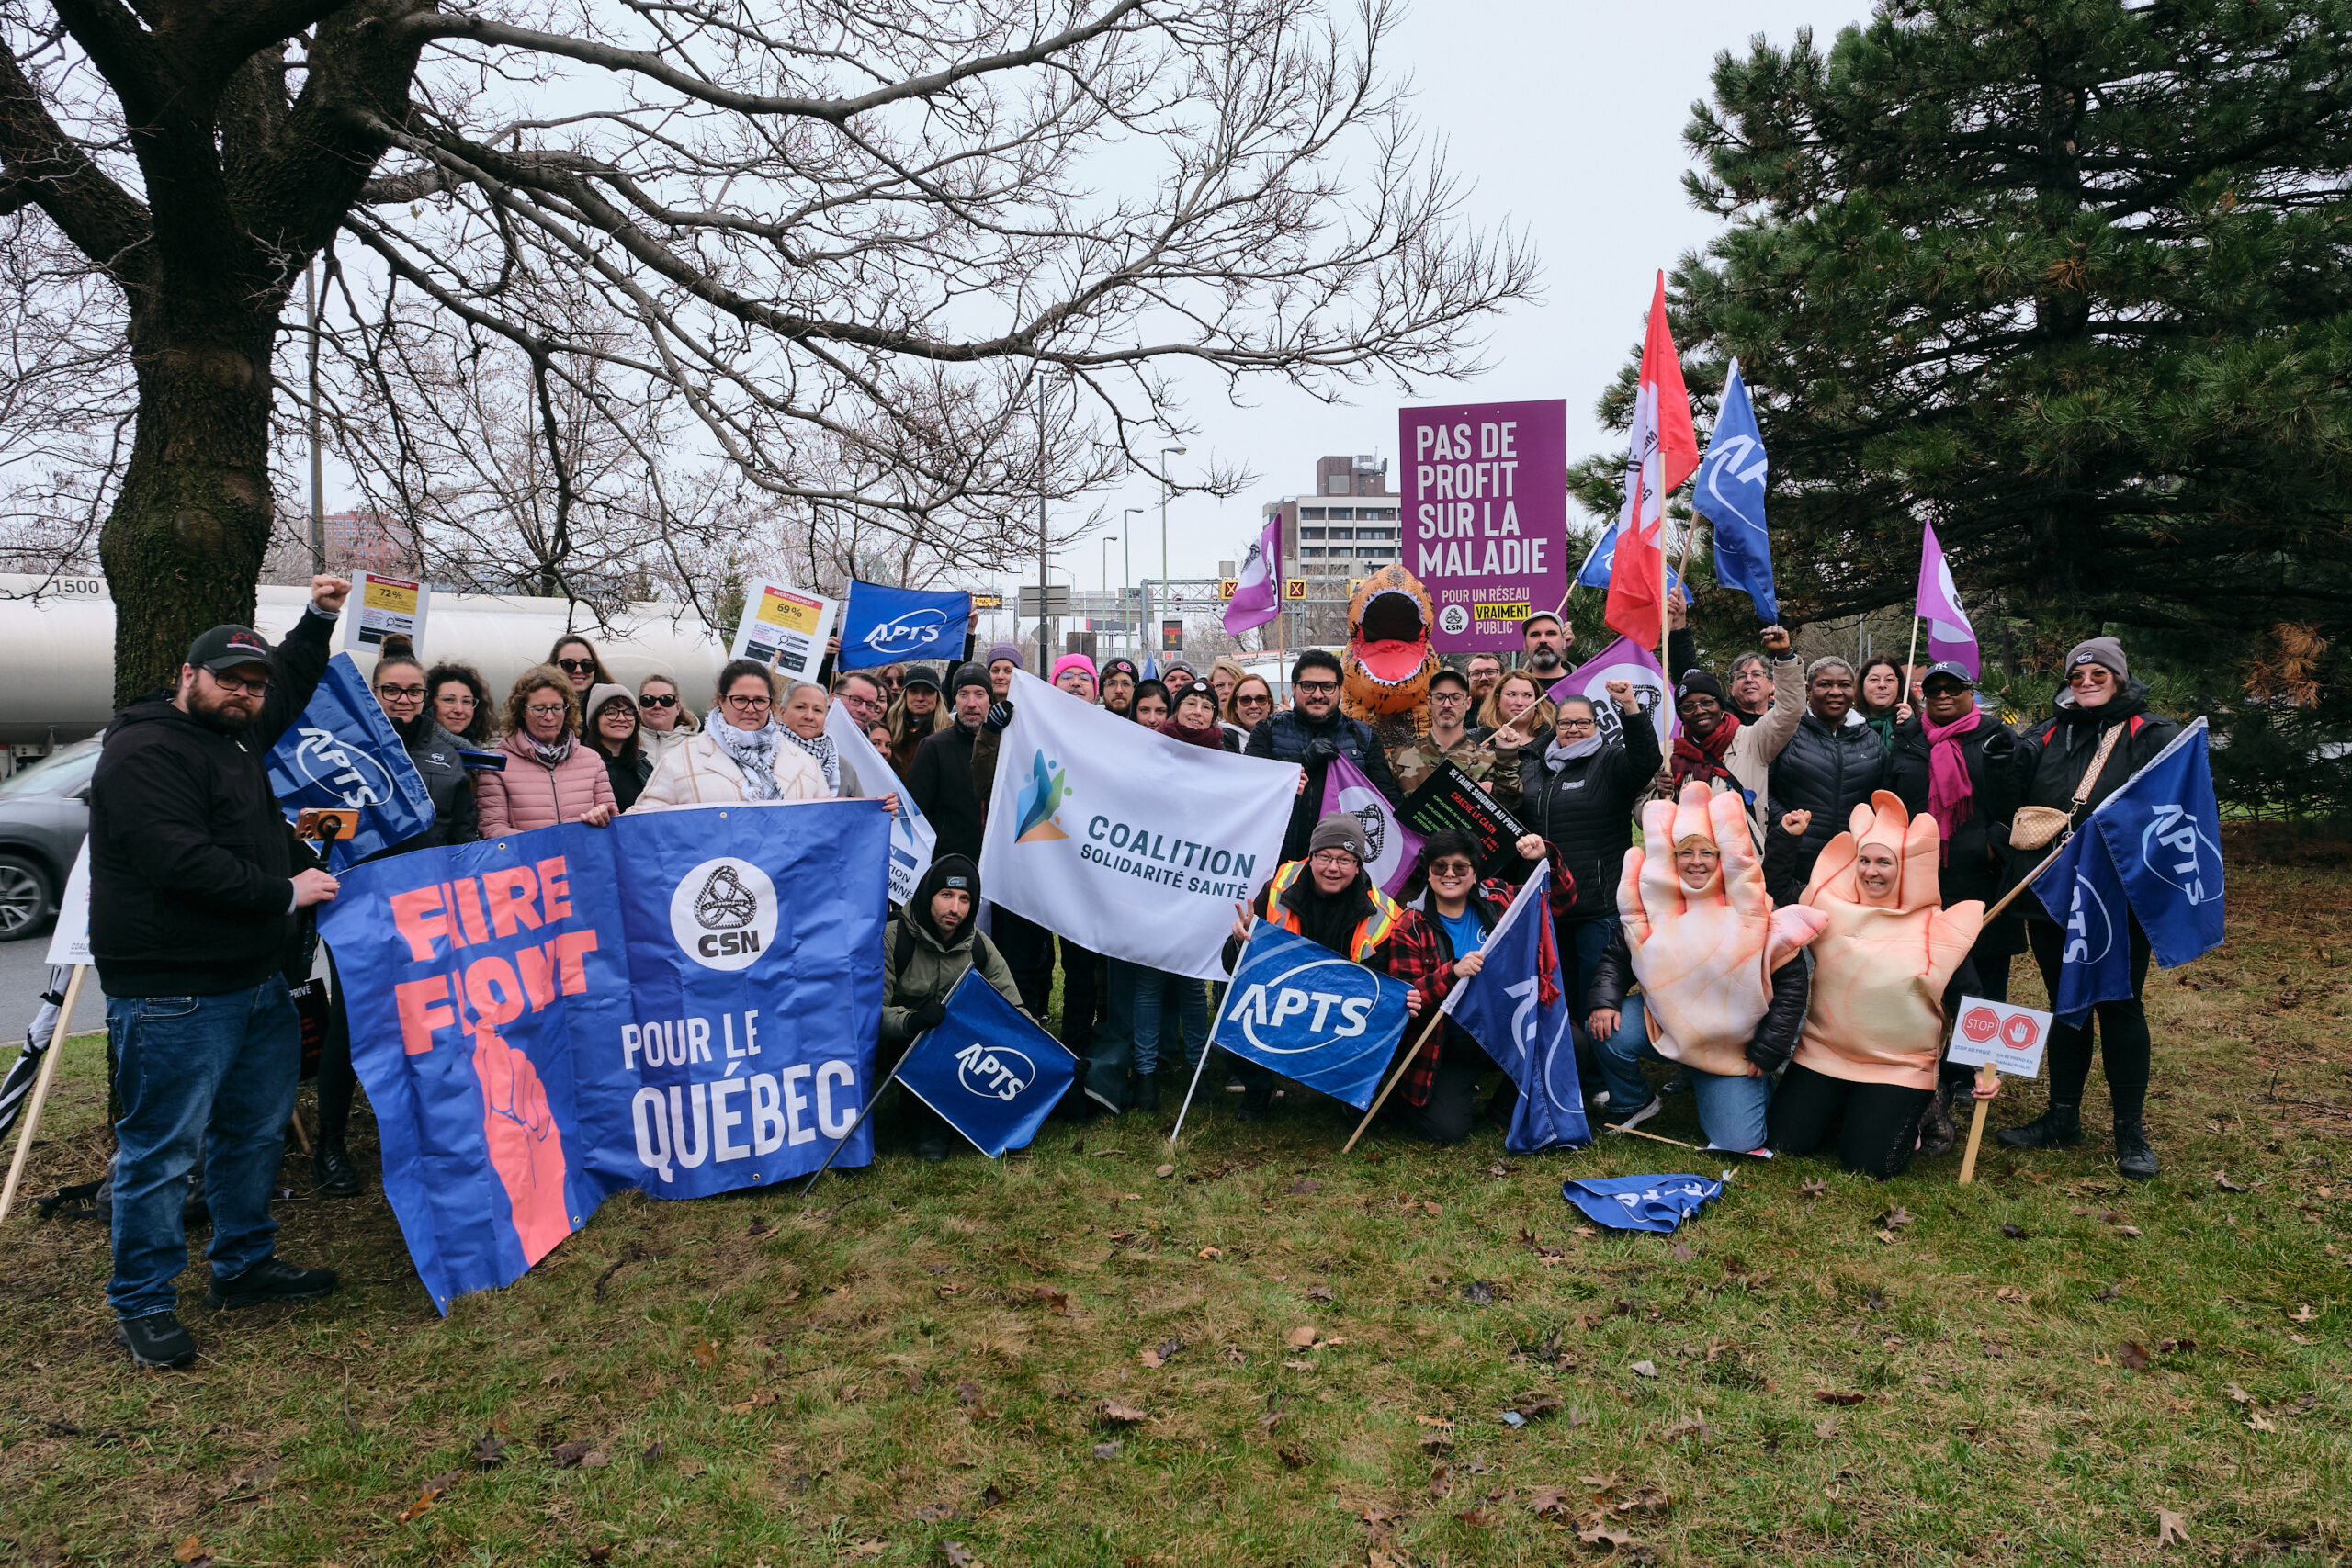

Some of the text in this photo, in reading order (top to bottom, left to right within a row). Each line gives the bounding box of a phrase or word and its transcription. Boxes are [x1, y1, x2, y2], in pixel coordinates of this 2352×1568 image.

[1417, 421, 1517, 461] PAS DE
[1418, 461, 1518, 501] PROFIT
[1419, 501, 1521, 539] SUR LA
[1419, 538, 1548, 578] MALADIE
[55, 579, 99, 594] 1500
[1442, 585, 1530, 604] POUR UN RÉSEAU
[1446, 623, 1463, 631] CSN
[1476, 604, 1530, 619] VRAIMENT
[1476, 621, 1513, 635] PUBLIC
[863, 623, 942, 642] APTS
[298, 728, 378, 808] APTS
[1448, 768, 1523, 836] SE FAIRE SOIGNER AU PRIVÉ
[1450, 791, 1498, 835] CRACHE LE CASH
[1088, 815, 1256, 879] COALITION
[2151, 805, 2204, 906] APTS
[1080, 844, 1248, 900] SOLIDARITÉ SANTÉ
[390, 855, 572, 962] FIRE
[698, 930, 760, 957] CSN
[1227, 983, 1373, 1037] APTS
[1967, 1018, 1995, 1032] STOP
[621, 1009, 761, 1070] POUR LE
[954, 1043, 1025, 1101] APTS
[631, 1060, 857, 1183] QUÉBEC
